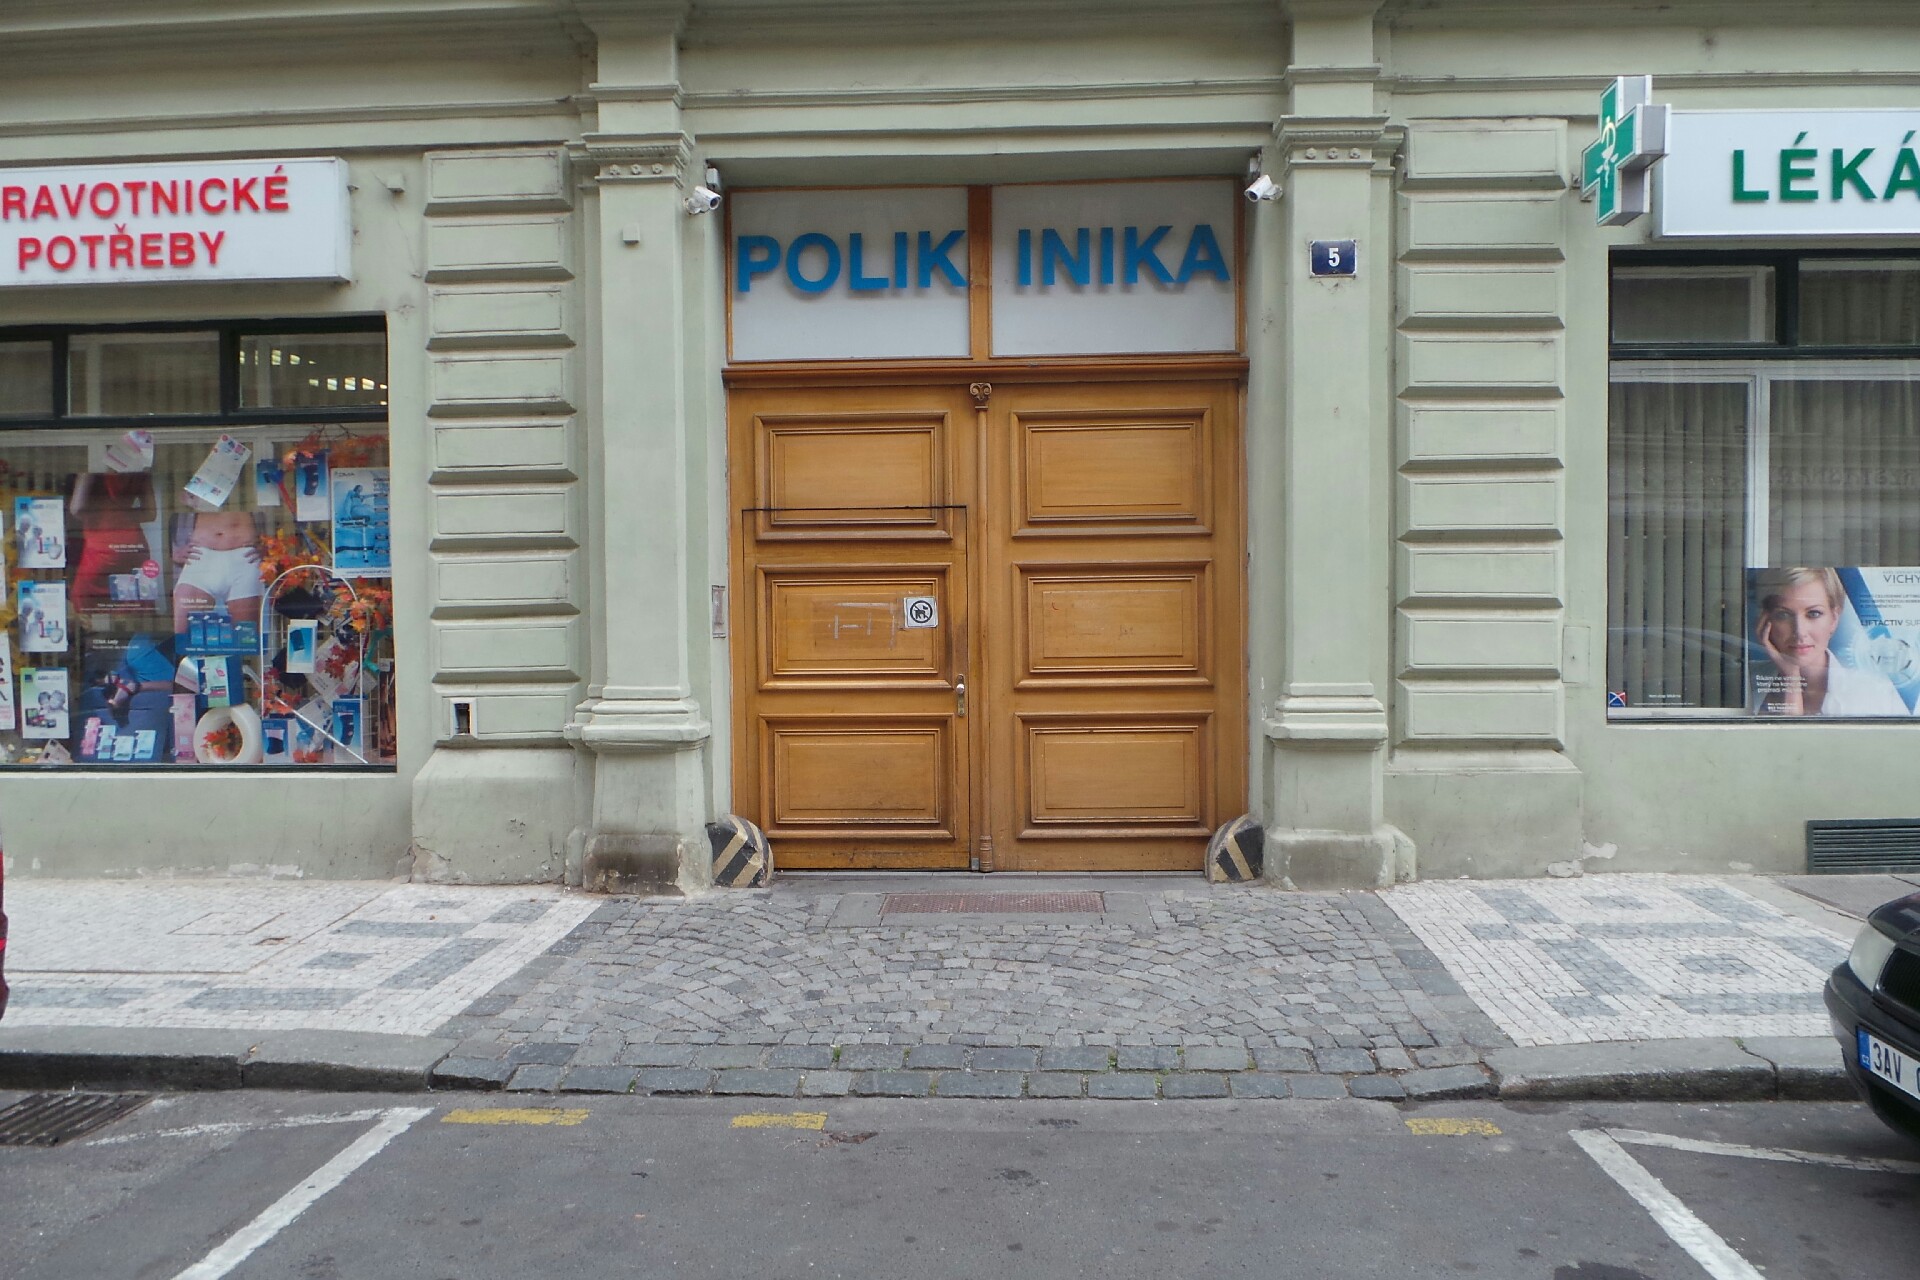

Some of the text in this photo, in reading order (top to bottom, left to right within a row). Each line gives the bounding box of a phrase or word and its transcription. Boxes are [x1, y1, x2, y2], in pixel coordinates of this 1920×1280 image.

[1732, 130, 1920, 202] LÉKÁ
[2, 165, 290, 220] RAVOTNICKÉ
[18, 223, 226, 272] POTŘEBY
[1328, 247, 1341, 268] 5
[1883, 574, 1920, 584] VICHY
[1860, 619, 1903, 627] LIFTACTIV
[1873, 1042, 1902, 1083] 3AV
